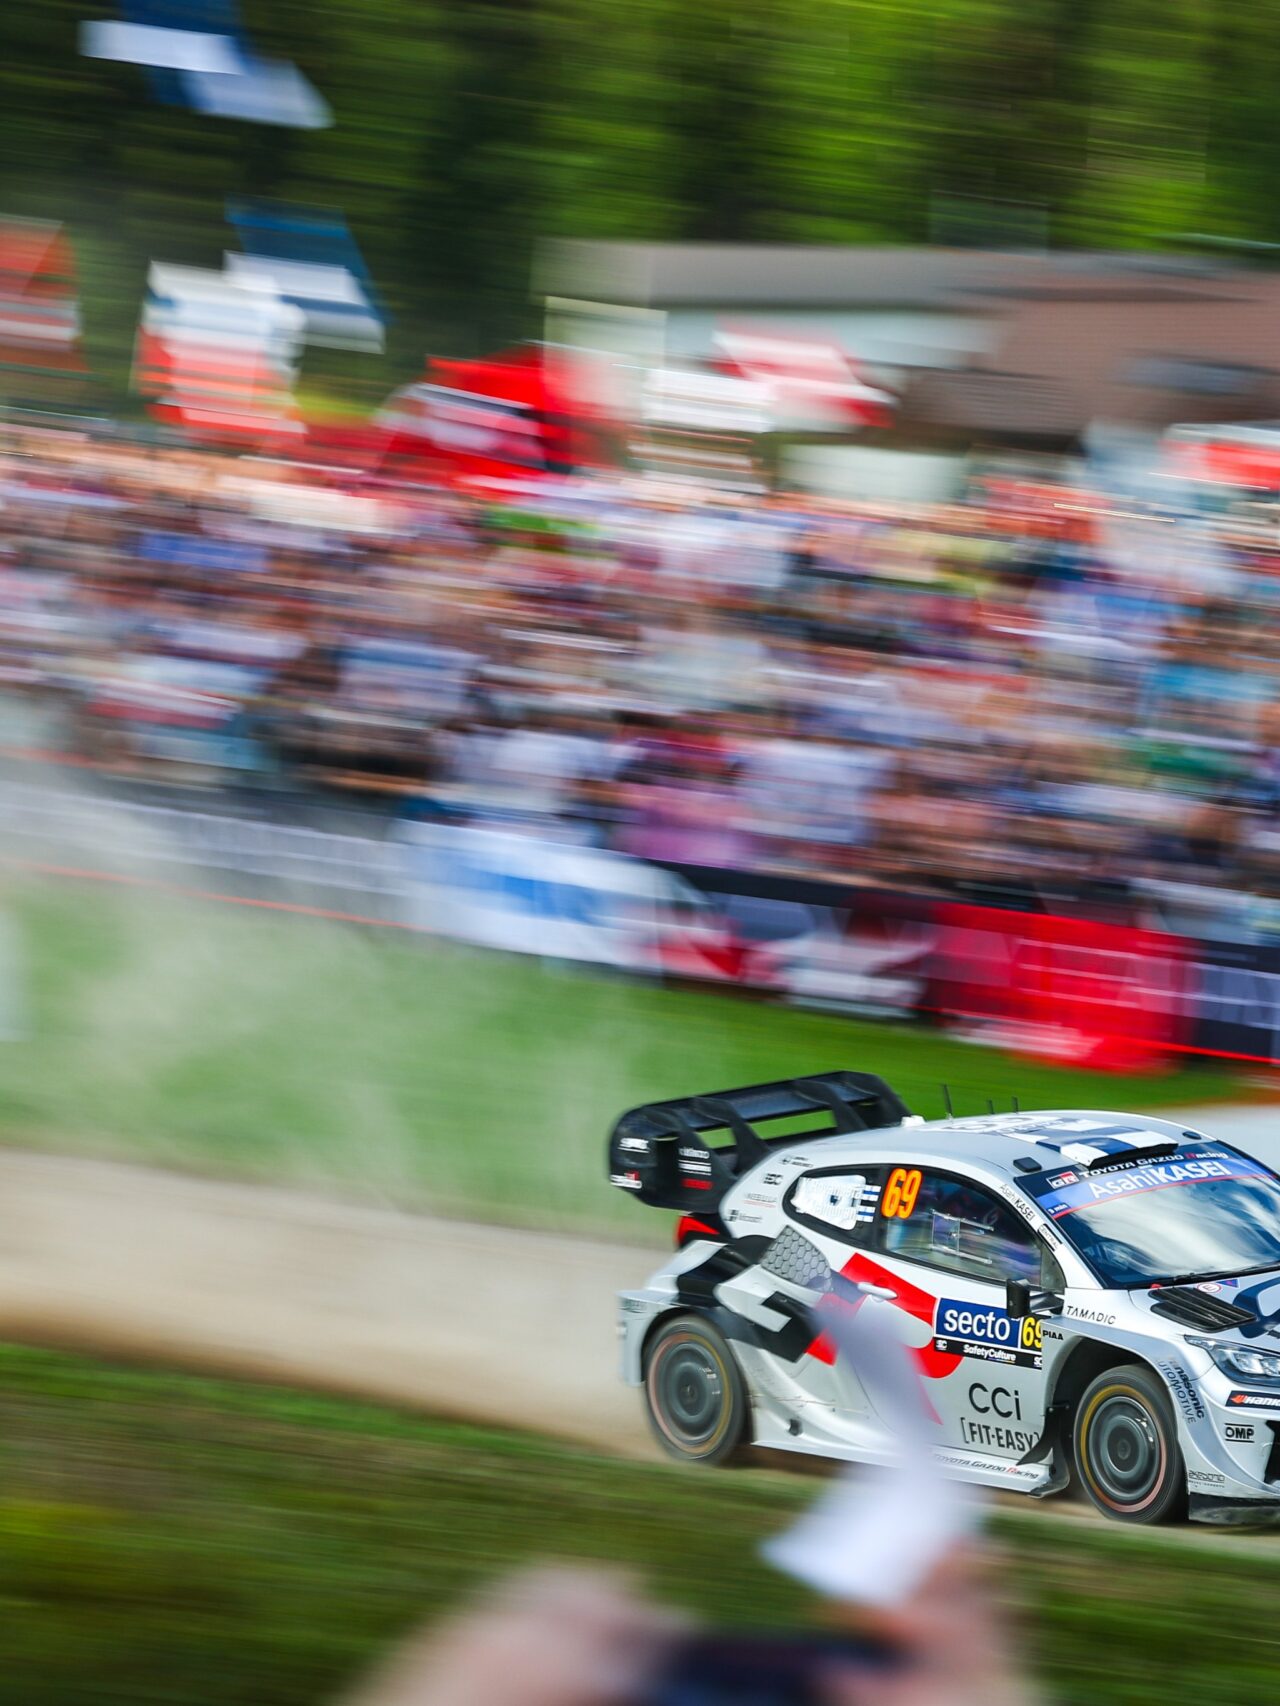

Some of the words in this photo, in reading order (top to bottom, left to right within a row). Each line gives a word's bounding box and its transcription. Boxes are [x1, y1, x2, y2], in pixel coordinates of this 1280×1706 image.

[1079, 1161, 1135, 1178] TOYOTA
[1137, 1154, 1184, 1166] GAZOO
[1184, 1151, 1229, 1161] Racing
[1049, 1173, 1079, 1188] GR
[1088, 1160, 1232, 1199] AsahiKASEI
[881, 1168, 923, 1219] 69
[944, 1309, 1010, 1341] secto
[1067, 1306, 1117, 1325] TAMADIC
[1043, 1330, 1064, 1341] PIAA
[963, 1344, 1016, 1362] SafetyCulture
[969, 1382, 1021, 1420] CCi
[1157, 1361, 1197, 1423] UTOMOTIVE
[1225, 1427, 1254, 1439] OMP
[971, 1460, 1007, 1473] GAZOO
[1006, 1467, 1040, 1479] Racing
